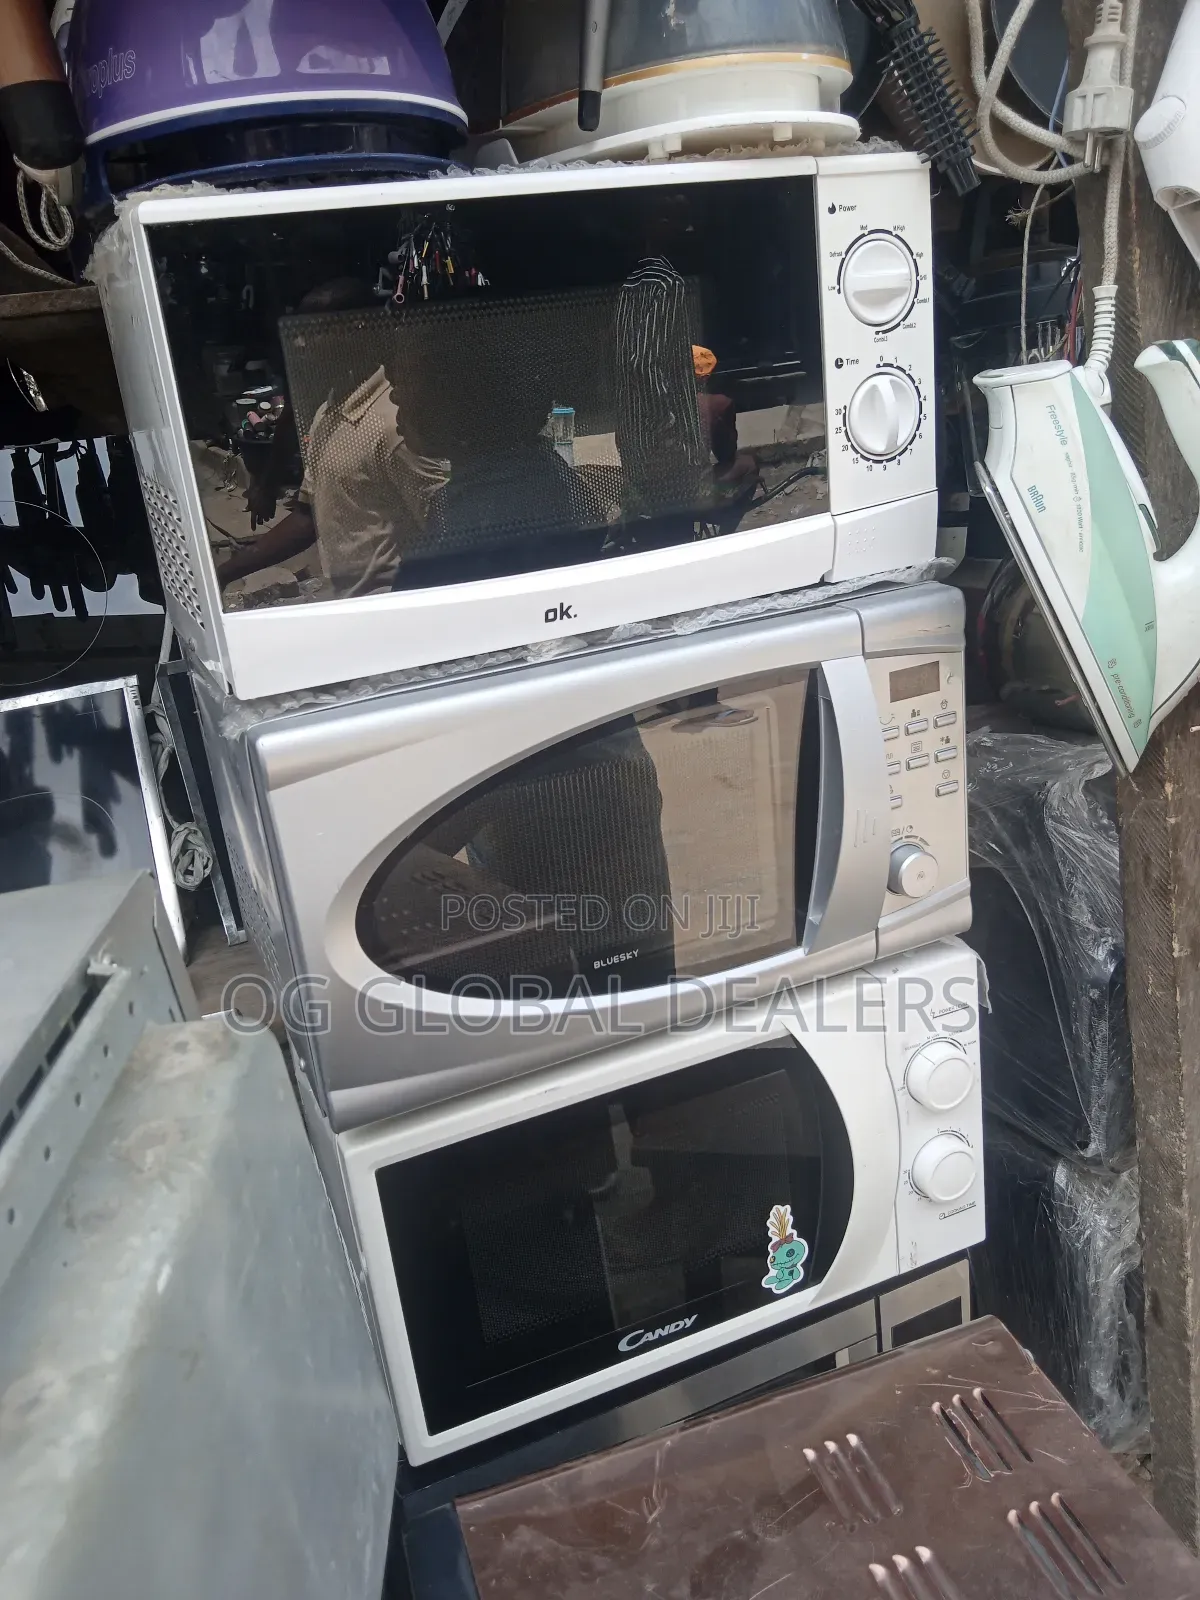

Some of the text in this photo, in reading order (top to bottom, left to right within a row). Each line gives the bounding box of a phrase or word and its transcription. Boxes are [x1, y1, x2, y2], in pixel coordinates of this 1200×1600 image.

[838, 204, 857, 212] Power
[846, 358, 860, 366] Time
[1045, 404, 1068, 446] Freestyle
[1027, 485, 1046, 513] BRAUN
[544, 601, 578, 623] ok.
[593, 949, 639, 969] BLUESKY
[618, 1314, 698, 1351] CANDY
